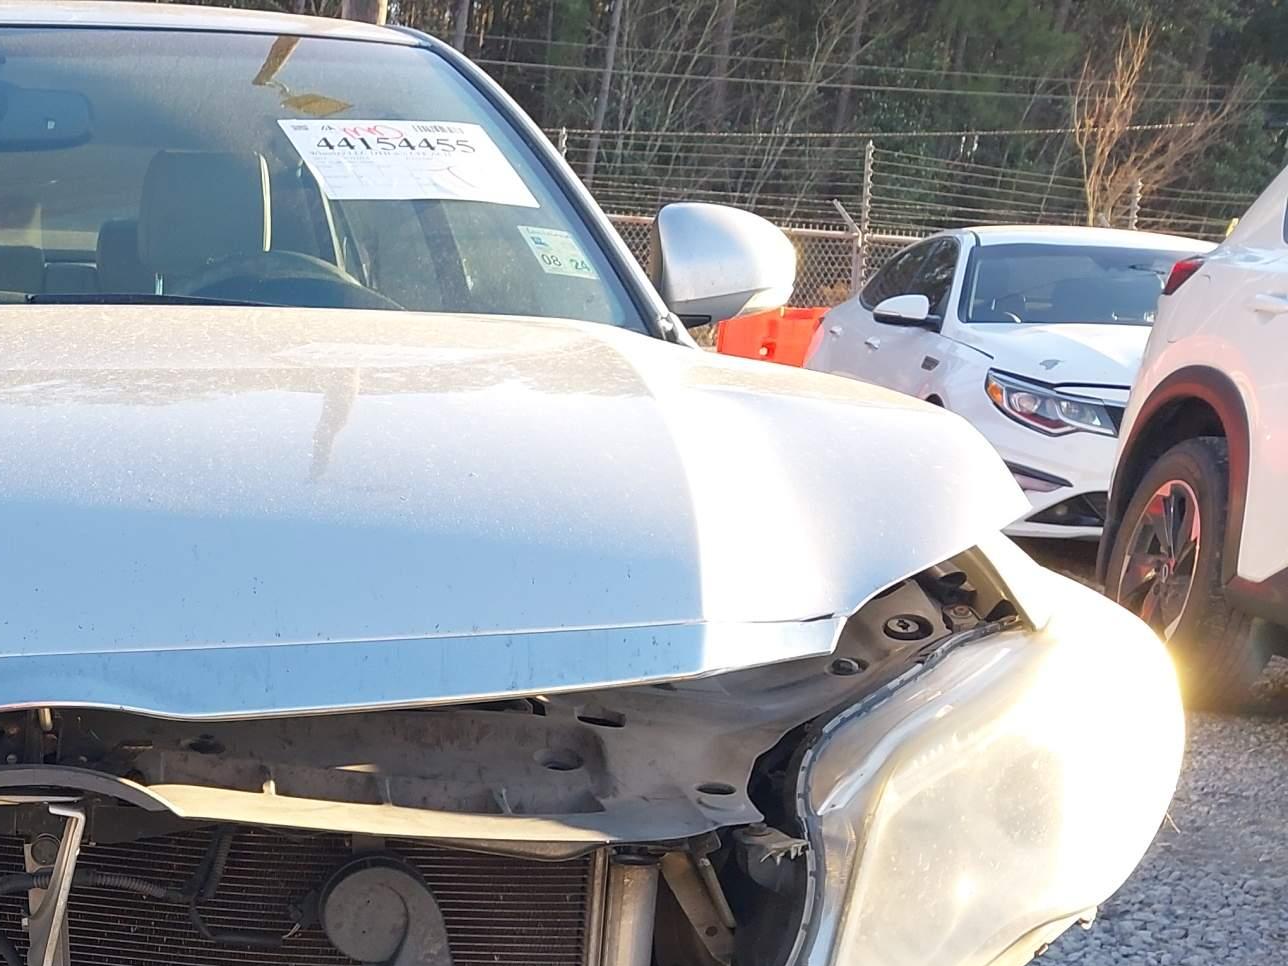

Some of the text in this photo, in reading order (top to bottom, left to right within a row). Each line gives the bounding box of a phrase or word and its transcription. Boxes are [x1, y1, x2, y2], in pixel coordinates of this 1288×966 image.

[316, 136, 477, 153] 44154455
[541, 254, 591, 272] 08 24
